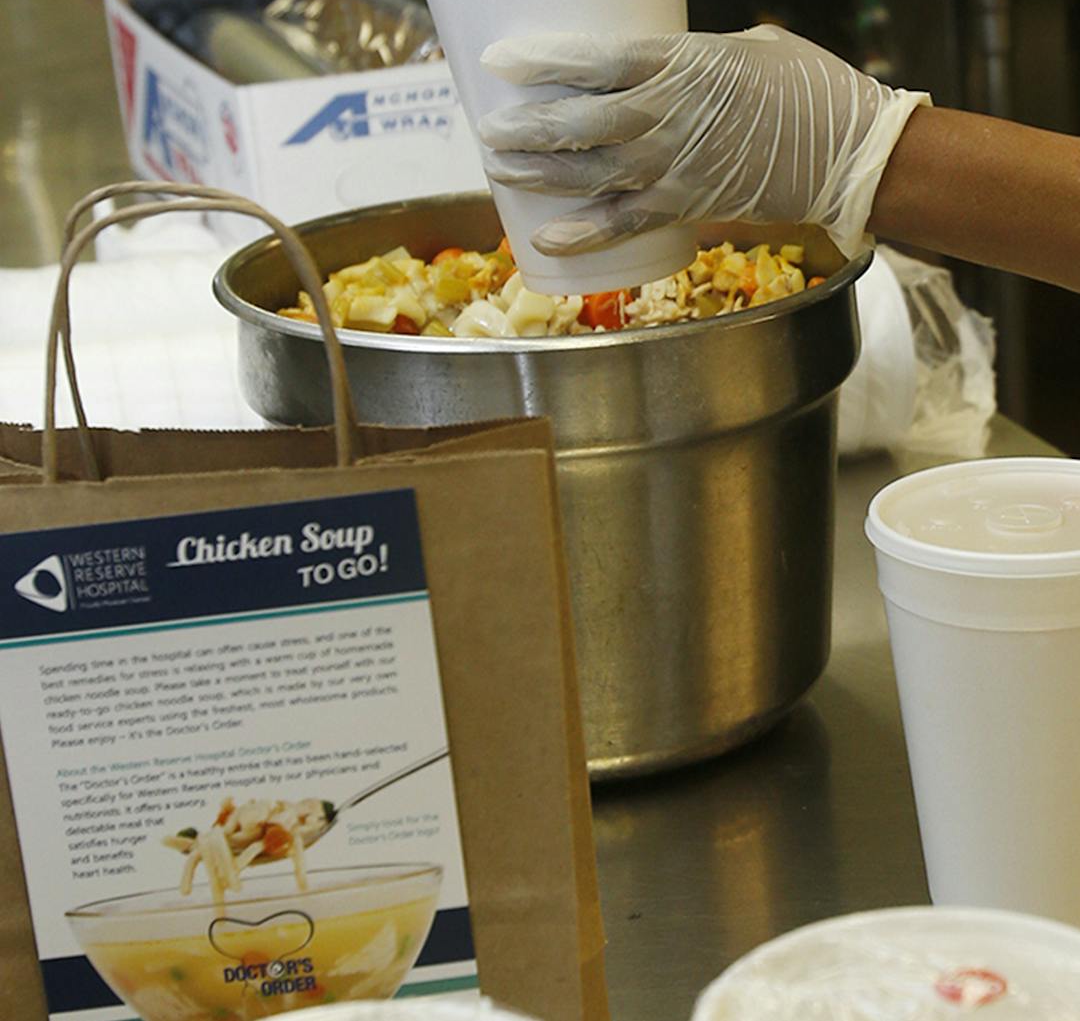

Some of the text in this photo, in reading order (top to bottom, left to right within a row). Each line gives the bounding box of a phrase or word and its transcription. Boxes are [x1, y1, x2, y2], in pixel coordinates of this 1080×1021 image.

[381, 116, 448, 131] WRAP
[166, 521, 374, 568] Chicken Soup
[69, 546, 146, 567] WESTERN
[297, 543, 389, 587] TO GO!
[74, 562, 147, 582] RESERVE
[76, 579, 149, 599] HOSPITAL
[39, 663, 87, 676] Spending
[91, 660, 114, 669] time
[131, 656, 148, 664] the
[152, 649, 192, 662] hospital
[196, 649, 213, 657] can
[218, 645, 243, 654] often
[248, 641, 276, 650] cause
[315, 633, 334, 643] and
[339, 632, 357, 640] one
[375, 627, 392, 635] the
[41, 680, 63, 690] best
[68, 675, 116, 686] remedies
[120, 672, 134, 681] for
[139, 669, 168, 679] stress
[184, 663, 225, 673] relaxing
[230, 658, 250, 667] with
[265, 654, 293, 663] warm
[297, 651, 317, 660] cup
[335, 642, 394, 655] homemade
[44, 694, 81, 705] chicken
[85, 688, 120, 700] noodle
[155, 682, 186, 691] Please
[190, 679, 211, 687] take
[225, 671, 266, 683] moment
[285, 667, 307, 676] treat
[312, 660, 350, 675] yourself
[354, 658, 374, 668] with
[379, 657, 396, 665] our
[47, 706, 110, 719] ready-to-go
[115, 701, 153, 712] chicken
[157, 695, 194, 706] noodle
[231, 687, 260, 697] which
[278, 682, 306, 691] made
[328, 678, 345, 686] our
[350, 675, 371, 683] very
[376, 672, 397, 680] own
[48, 723, 74, 734] food
[78, 721, 113, 731] service
[118, 715, 156, 726] experts
[160, 712, 188, 721] using
[191, 709, 208, 718] the
[260, 699, 285, 708] most
[289, 693, 348, 705] wholesome
[52, 739, 84, 748] Please
[88, 736, 116, 746] enjoy
[146, 729, 163, 737] the
[56, 768, 87, 778] About
[90, 765, 106, 774] the
[110, 761, 150, 771] Western
[153, 756, 191, 767] Reserve
[195, 750, 235, 761] Hospital
[282, 741, 311, 752] Order
[59, 783, 78, 792] The
[187, 766, 225, 777] healthy
[263, 759, 283, 768] that
[306, 754, 331, 764] been
[334, 743, 407, 759] hand-selected
[61, 794, 116, 808] specifically
[118, 791, 133, 800] for
[137, 787, 178, 798] Western
[182, 782, 221, 792] Reserve
[224, 775, 266, 787] Hospital
[286, 772, 302, 780] our
[306, 765, 357, 779] physicians
[361, 761, 380, 771] and
[135, 803, 161, 813] offers
[66, 818, 164, 836] delectable meal that
[68, 835, 147, 851] satisfies hunger
[71, 850, 134, 865] and benefits
[73, 869, 99, 878] heart
[224, 957, 313, 983] DOCTOR'S
[261, 976, 316, 997] ORDER
